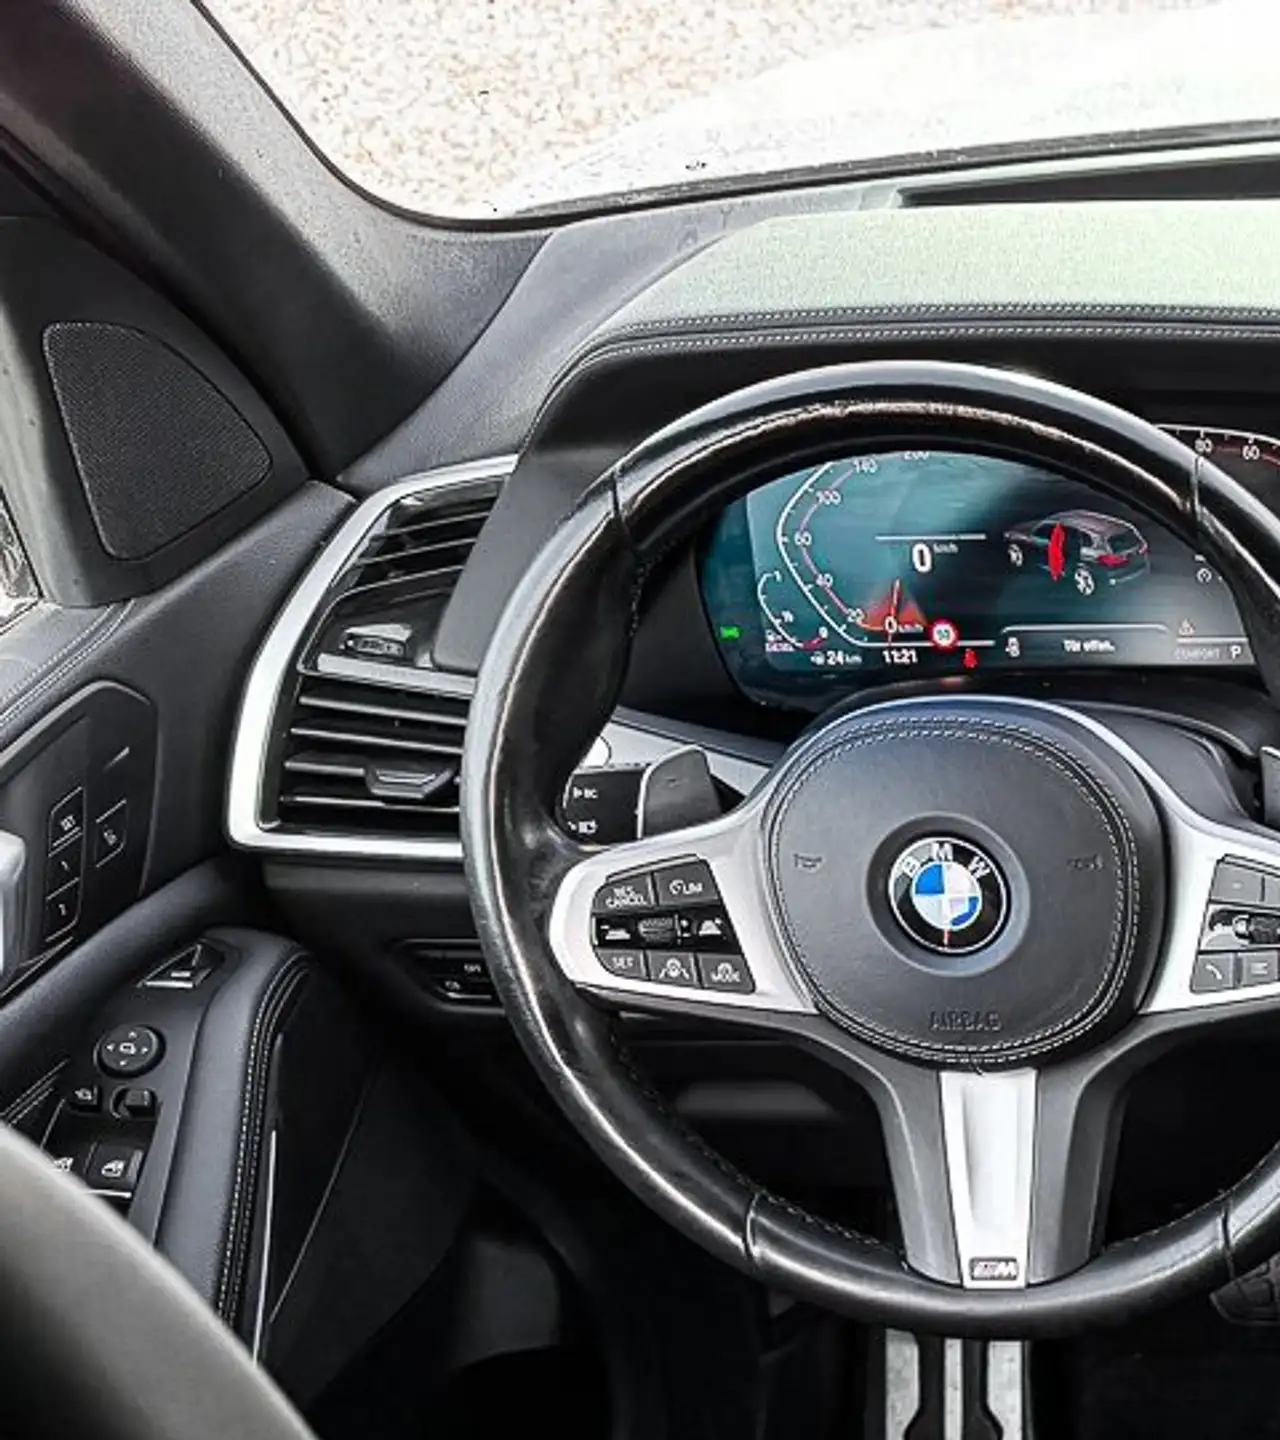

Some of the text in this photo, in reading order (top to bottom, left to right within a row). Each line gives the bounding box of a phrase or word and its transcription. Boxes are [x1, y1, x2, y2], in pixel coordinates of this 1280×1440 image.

[1242, 445, 1260, 460] 60
[794, 531, 812, 546] 60
[912, 543, 933, 573] 0
[885, 616, 897, 633] 0
[827, 651, 844, 665] 24
[883, 649, 918, 664] 11:21
[1230, 645, 1242, 659] P
[901, 843, 991, 879] BMW
[931, 1009, 1003, 1031] AIRBAG
